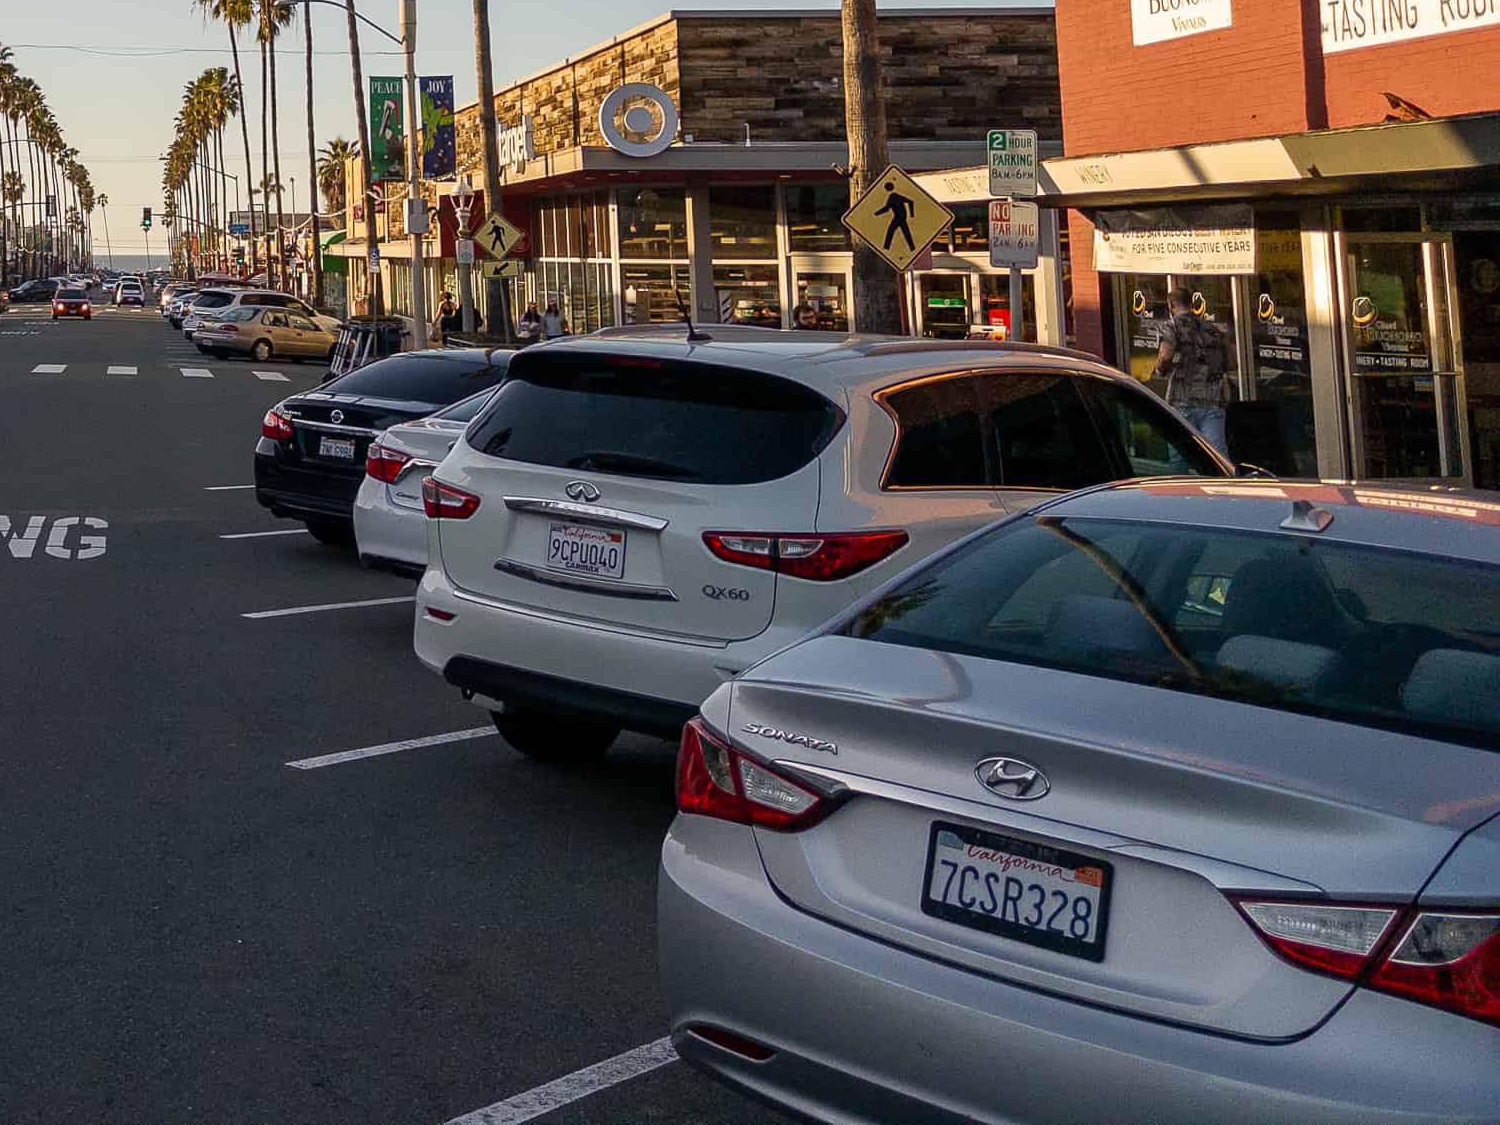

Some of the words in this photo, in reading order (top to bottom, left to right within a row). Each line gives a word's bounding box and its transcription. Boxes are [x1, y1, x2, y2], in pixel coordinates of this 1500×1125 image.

[371, 81, 401, 94] PEACE
[426, 79, 447, 93] JOY
[992, 133, 1004, 148] 2
[1008, 137, 1032, 148] HOUR
[992, 154, 1033, 166] PARKING
[992, 204, 1010, 220] NO
[992, 222, 1035, 236] PARING
[1132, 243, 1146, 254] FOR
[1148, 243, 1165, 254] FIVE
[1166, 242, 1221, 254] CONSECUTIVE
[1223, 241, 1251, 252] YEARS
[563, 526, 612, 544] California
[702, 584, 750, 601] QX60
[740, 722, 838, 756] SONATA
[966, 843, 1078, 882] California
[940, 858, 1093, 940] 7CSR328
